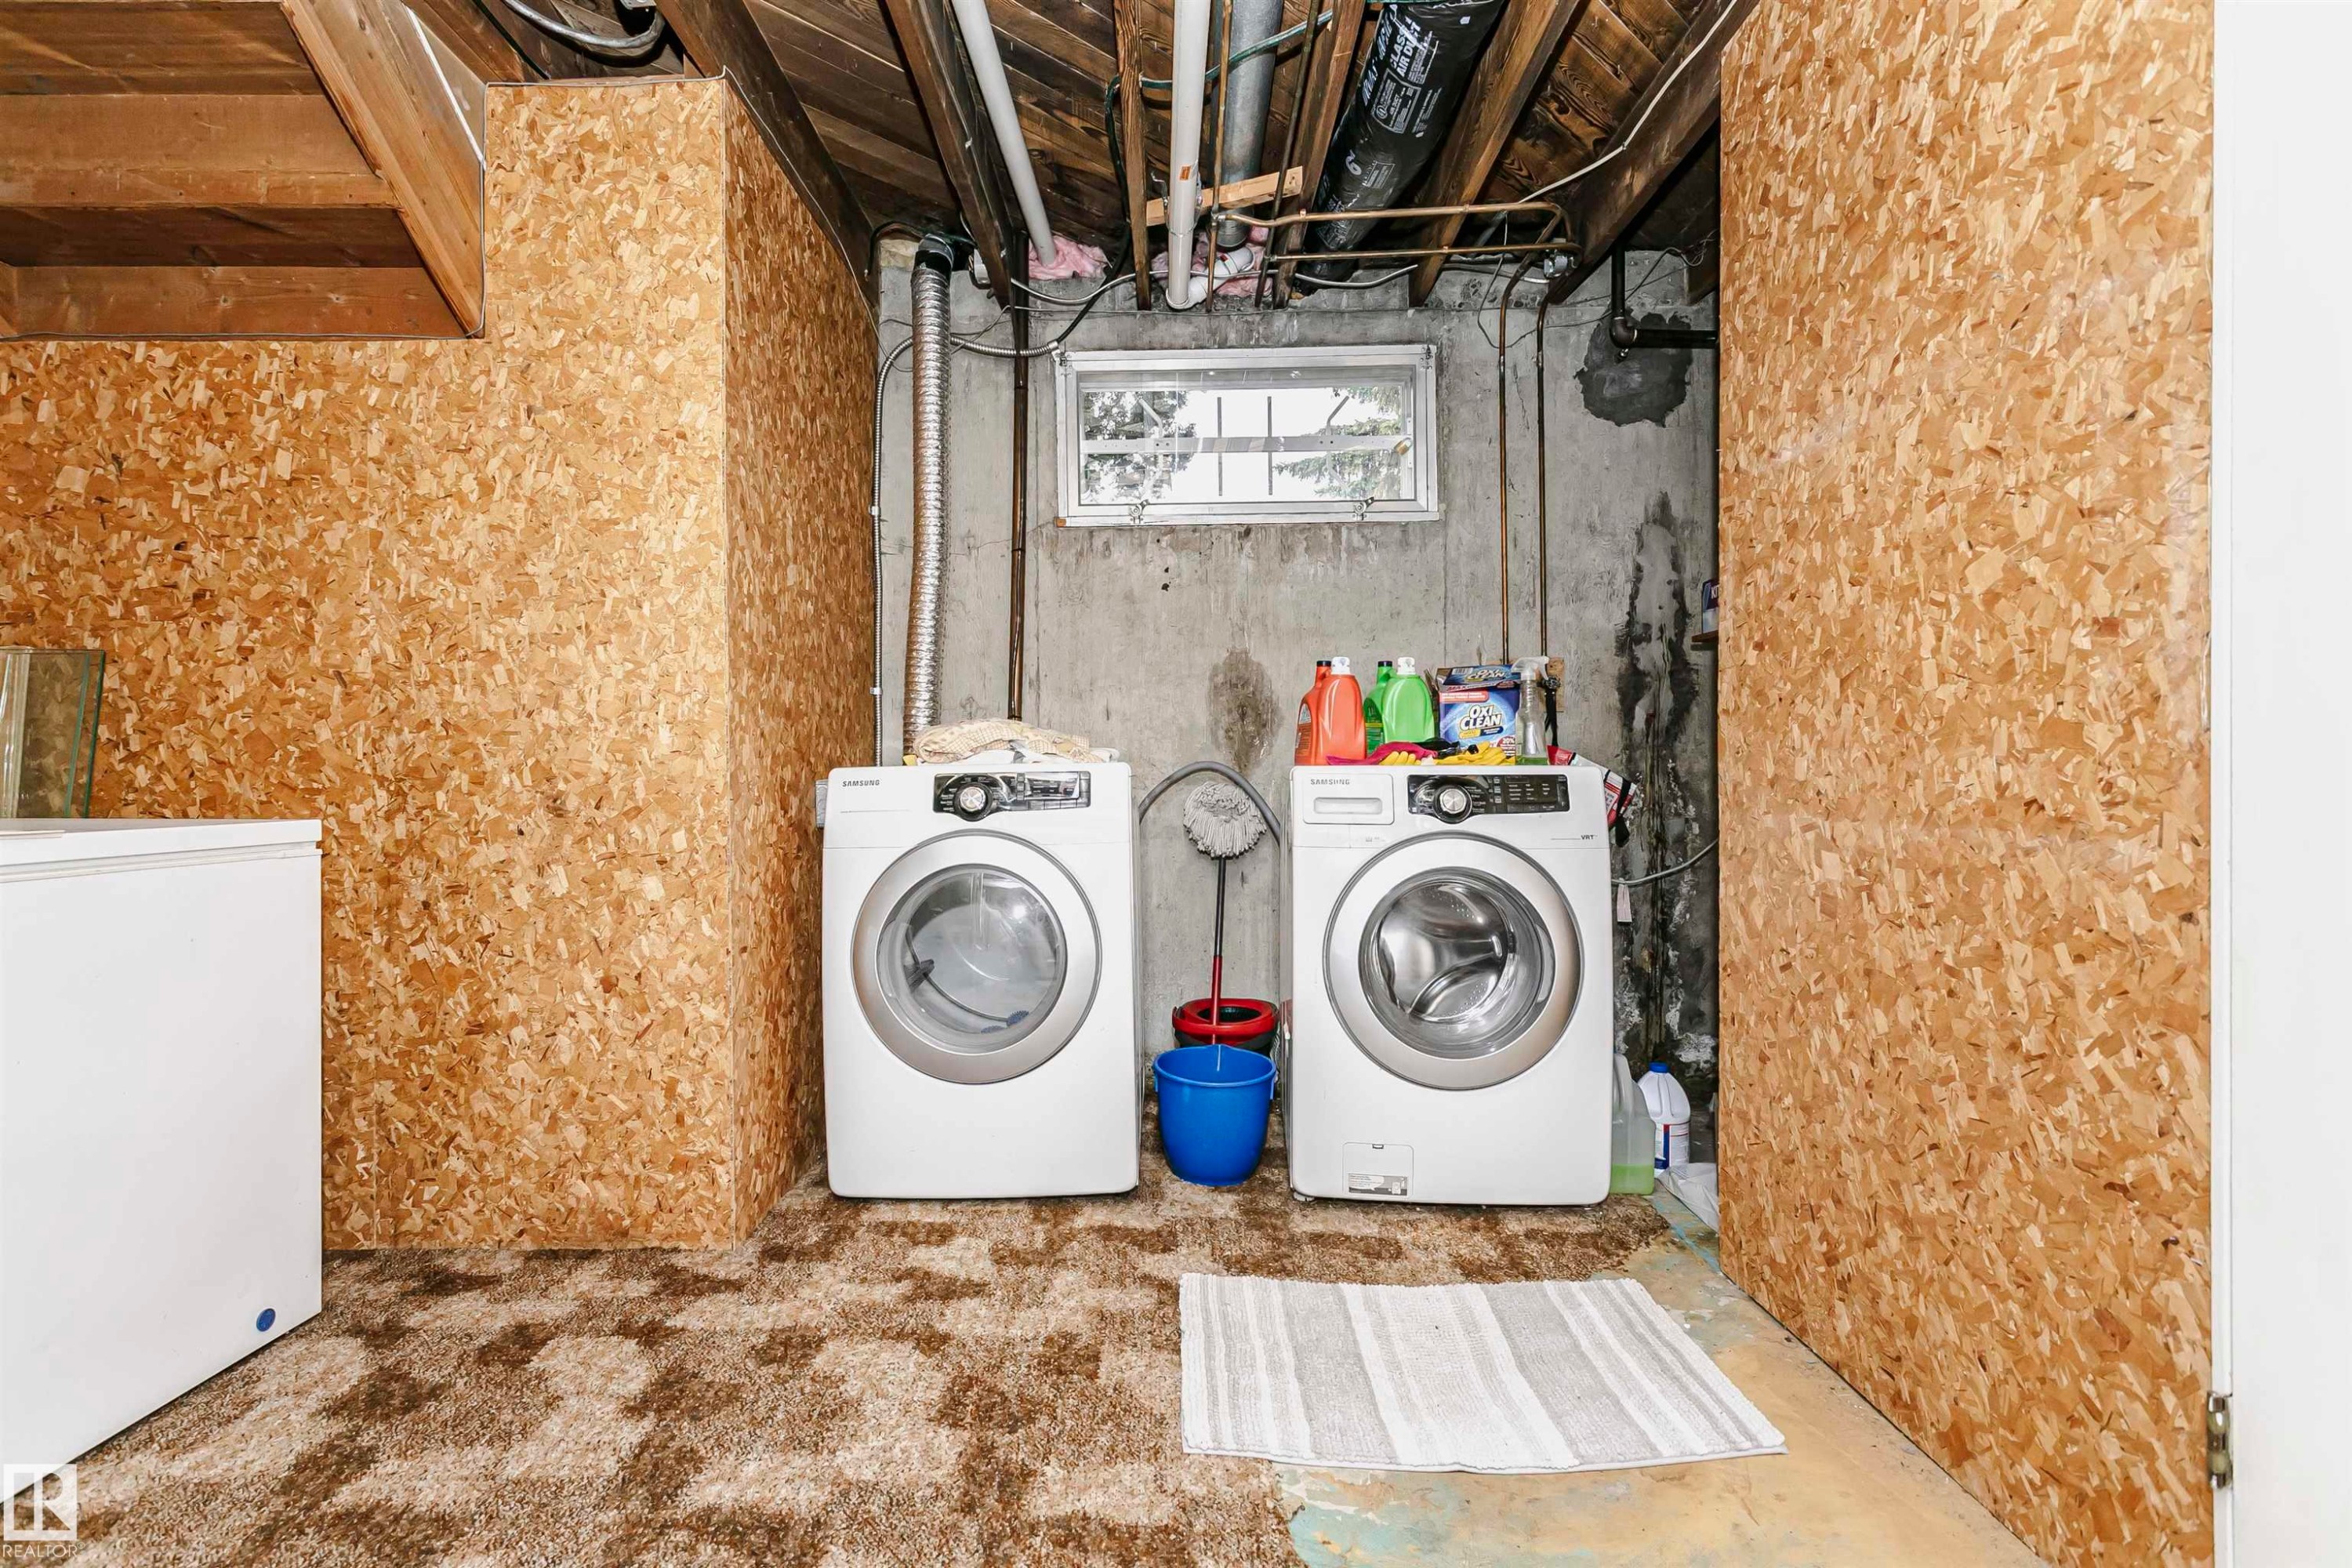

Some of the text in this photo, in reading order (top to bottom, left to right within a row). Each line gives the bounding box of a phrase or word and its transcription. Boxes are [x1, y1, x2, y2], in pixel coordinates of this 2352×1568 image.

[1396, 54, 1410, 78] AIR
[1469, 705, 1494, 719] OXI
[1460, 713, 1502, 731] CLEAN
